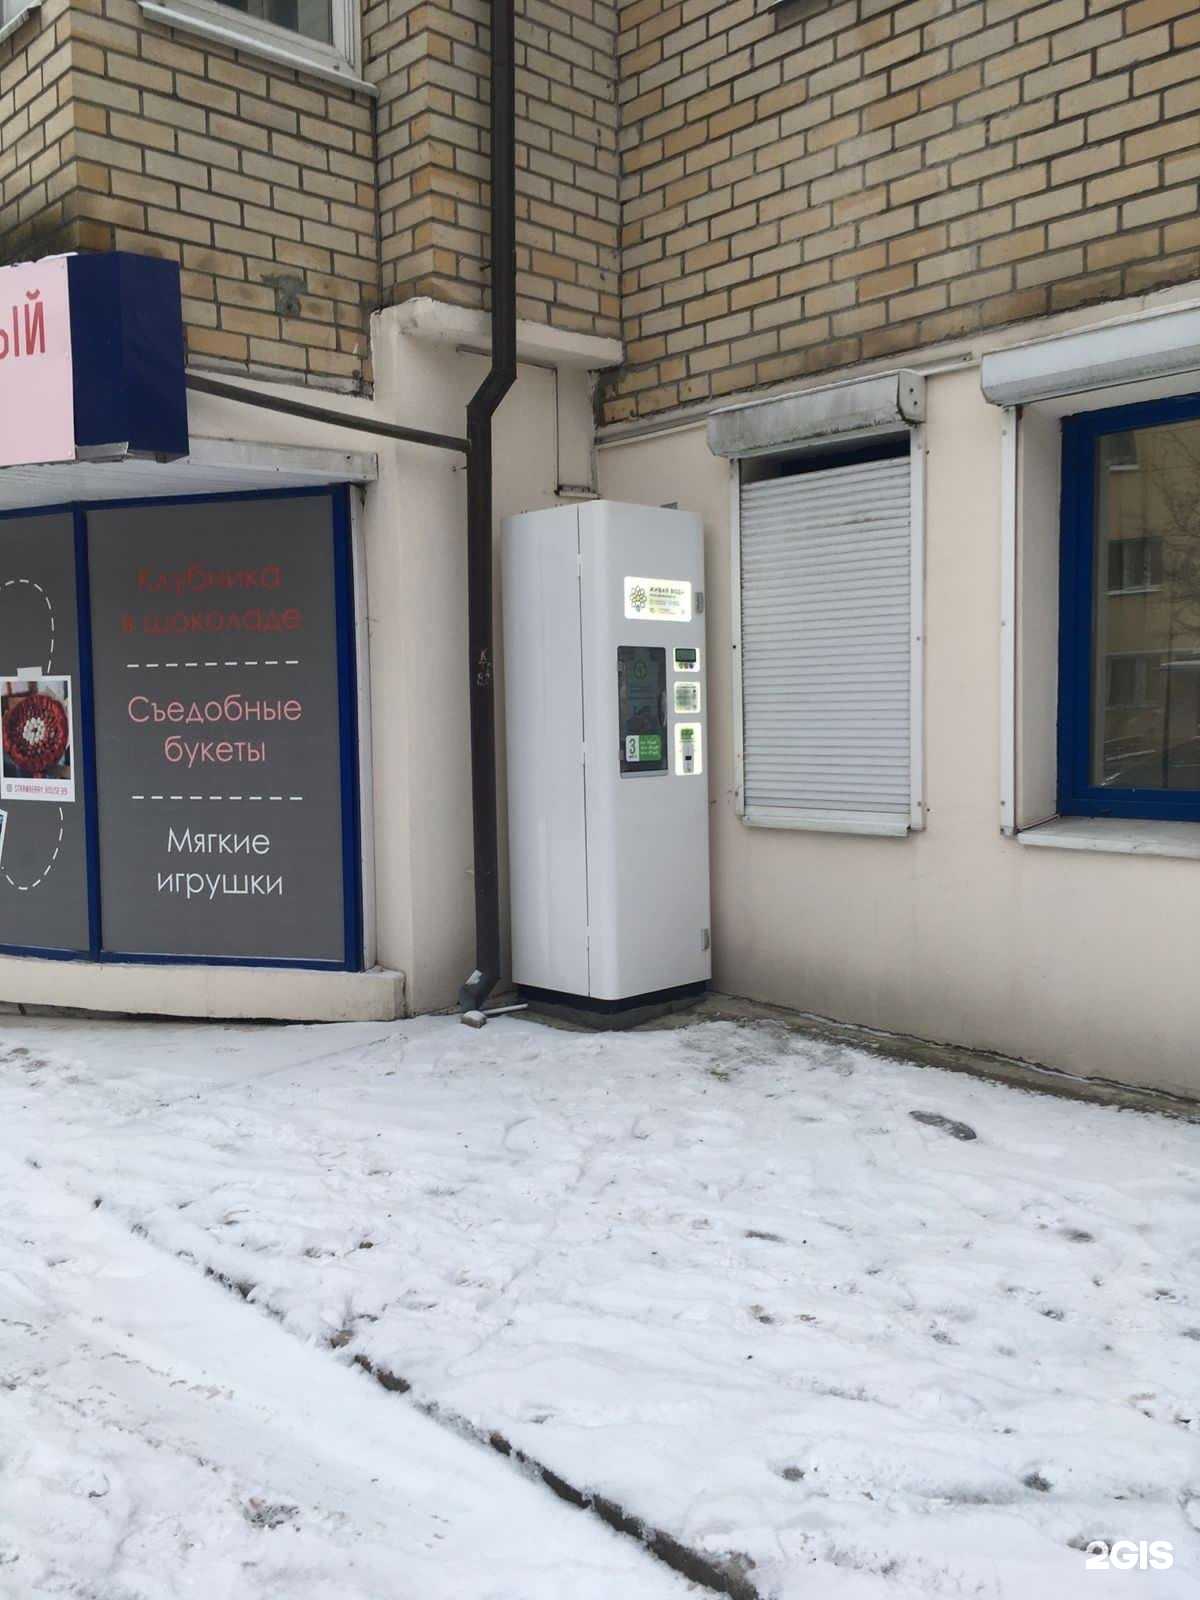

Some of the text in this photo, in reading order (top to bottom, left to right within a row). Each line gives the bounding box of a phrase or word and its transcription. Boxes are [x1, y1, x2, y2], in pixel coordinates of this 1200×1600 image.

[136, 563, 284, 598] Клубника
[141, 607, 304, 636] шоколаде
[127, 693, 303, 725] Съедобные
[164, 736, 267, 768] букеты
[167, 827, 271, 856] Мягкие
[157, 871, 284, 900] игрушки
